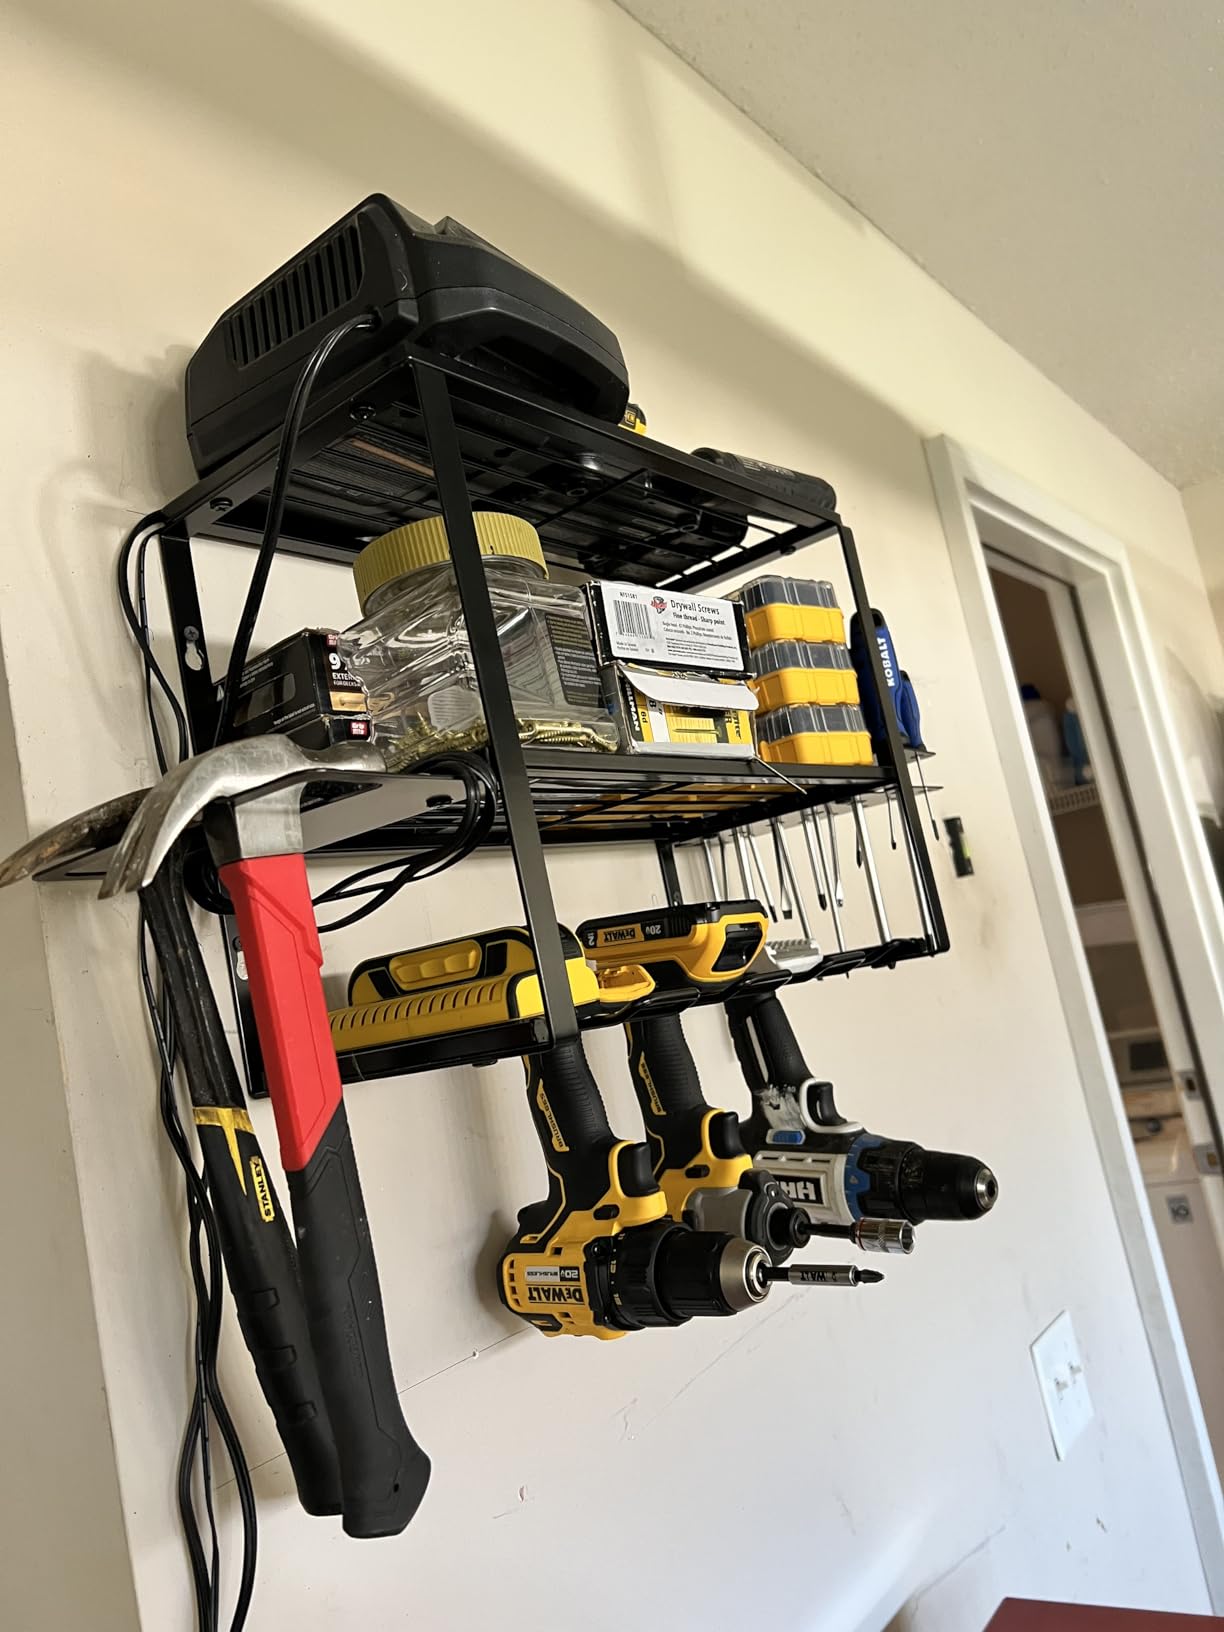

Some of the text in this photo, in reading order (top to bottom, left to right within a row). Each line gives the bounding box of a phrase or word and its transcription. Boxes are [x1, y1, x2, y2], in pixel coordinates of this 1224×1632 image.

[670, 599, 697, 612] Drywall
[697, 603, 720, 615] Screws
[700, 616, 713, 625] Sharp
[876, 637, 896, 687] KOBALT
[253, 1161, 272, 1217] STANLEY
[528, 1286, 585, 1303] DEWALT
